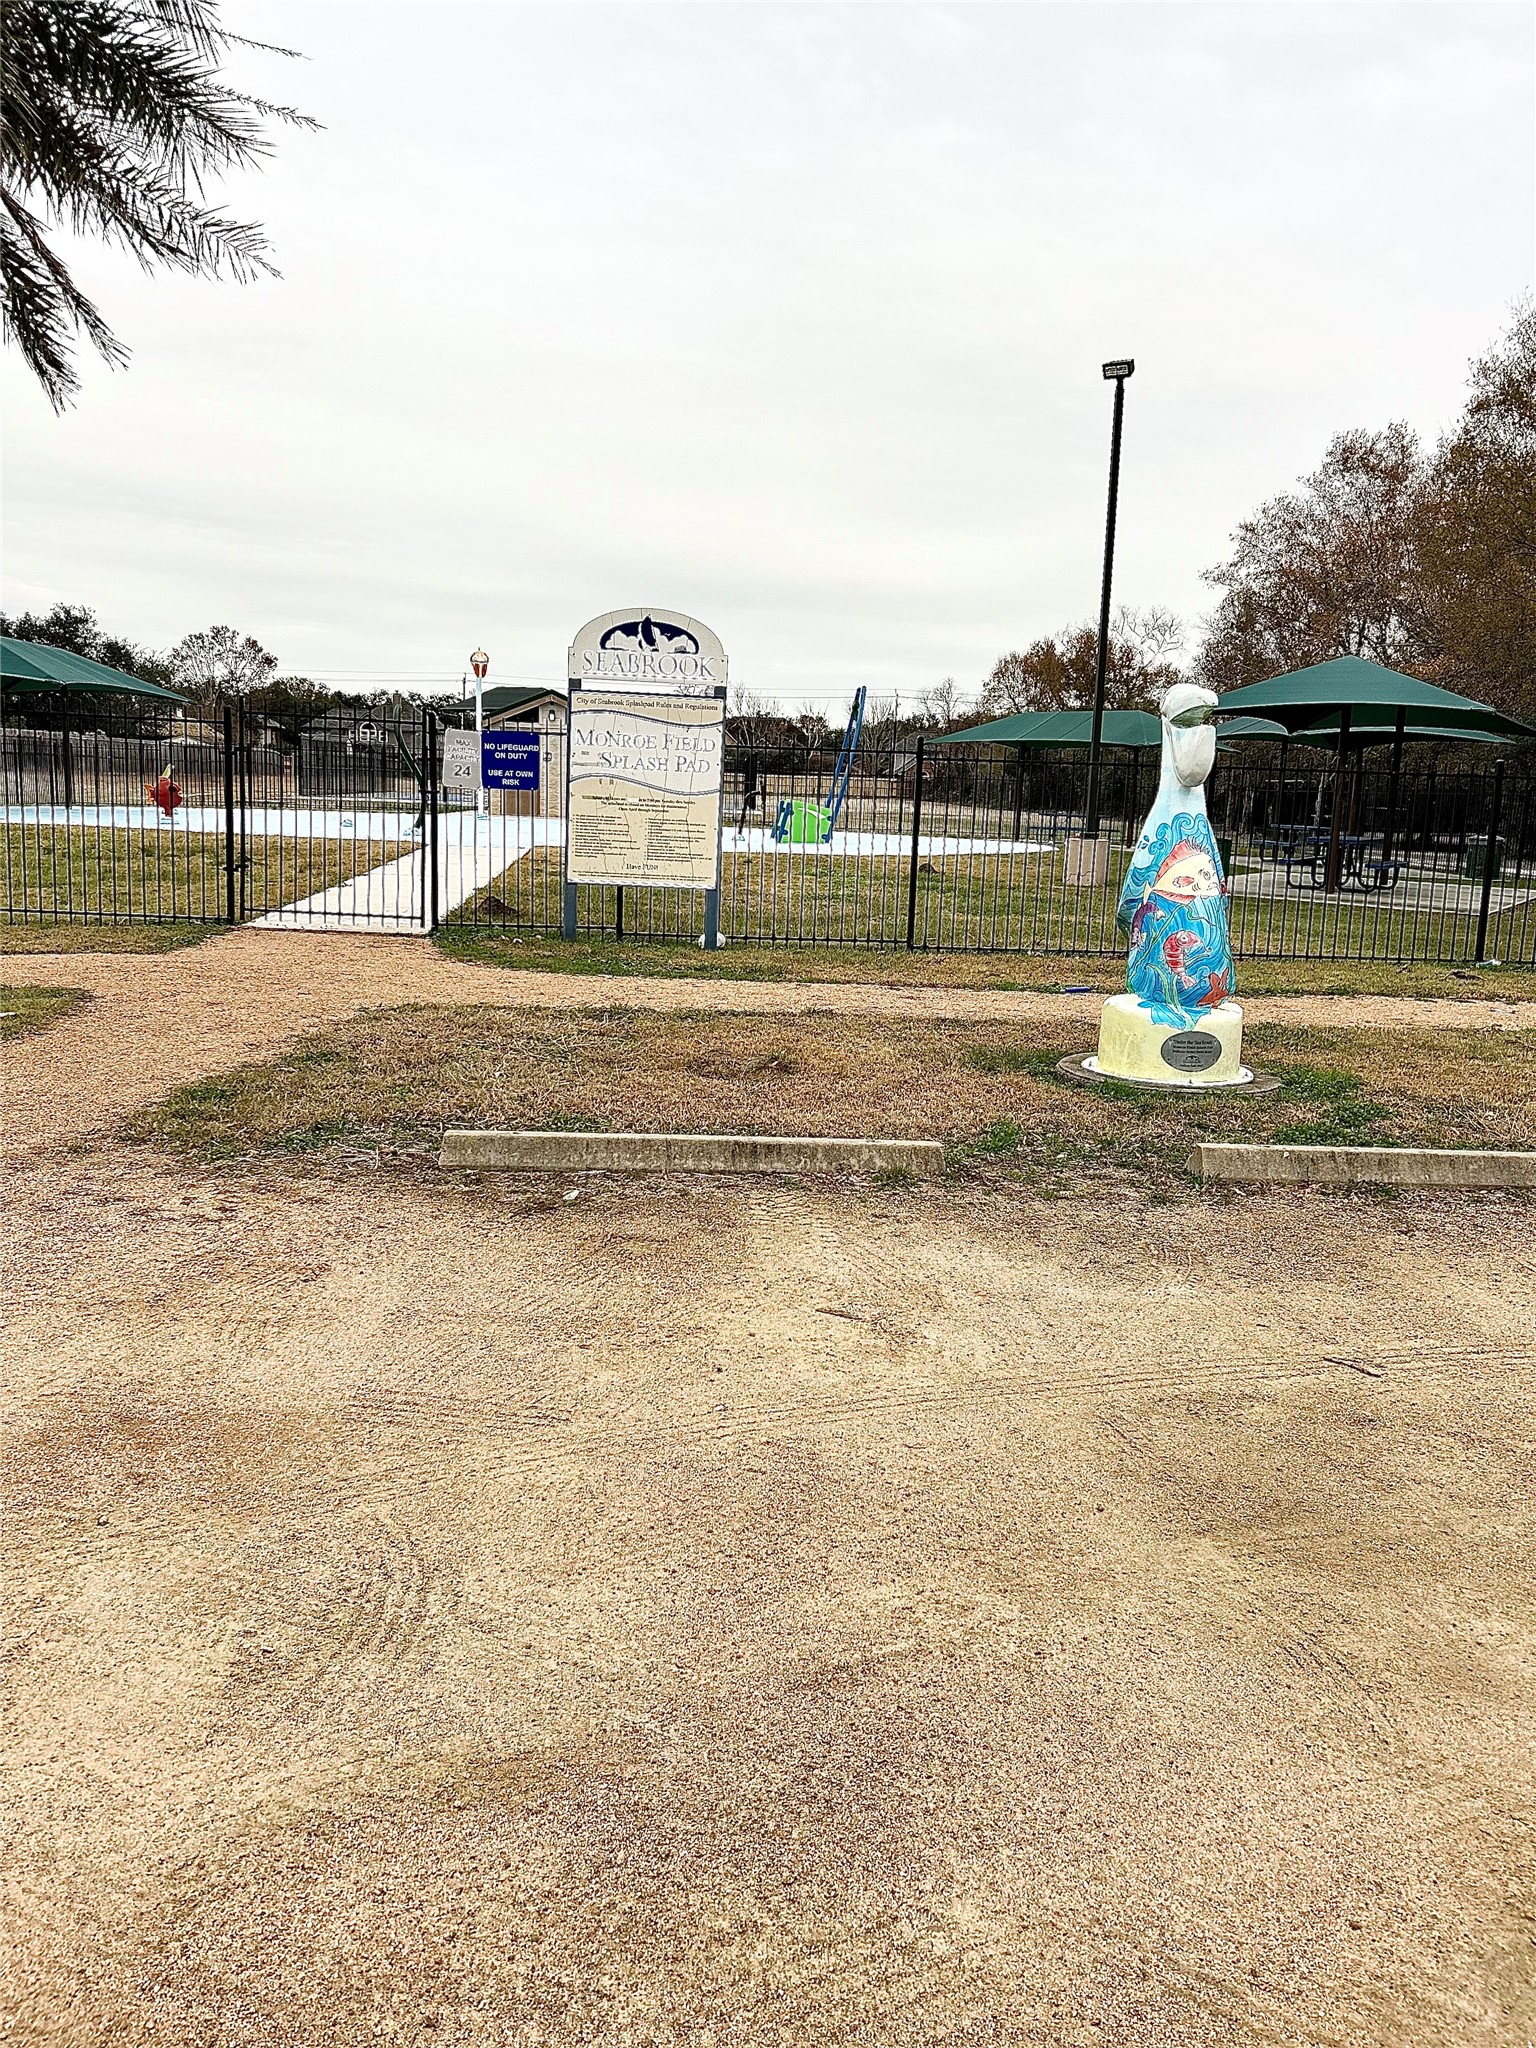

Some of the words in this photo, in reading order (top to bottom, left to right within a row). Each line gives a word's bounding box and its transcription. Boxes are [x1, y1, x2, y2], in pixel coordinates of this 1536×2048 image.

[582, 651, 716, 678] SEABROOK
[576, 696, 589, 705] City
[598, 698, 625, 706] Seabrook
[625, 699, 655, 709] Splashpad
[656, 700, 672, 708] Rules
[684, 702, 718, 712] Regulations
[455, 738, 472, 746] MAX
[574, 728, 657, 750] MONROE
[662, 732, 716, 753] FIELD
[447, 745, 479, 755] FACILITY
[484, 742, 495, 750] NO
[497, 743, 539, 752] LIFEGUARD
[445, 753, 480, 763] CAPACITY
[507, 752, 528, 760] DUTY
[600, 751, 669, 771] SPLASH
[674, 754, 711, 773] PAD
[453, 764, 472, 777] 24
[488, 769, 503, 777] USE
[515, 770, 534, 778] OWN
[502, 778, 520, 786] RISK
